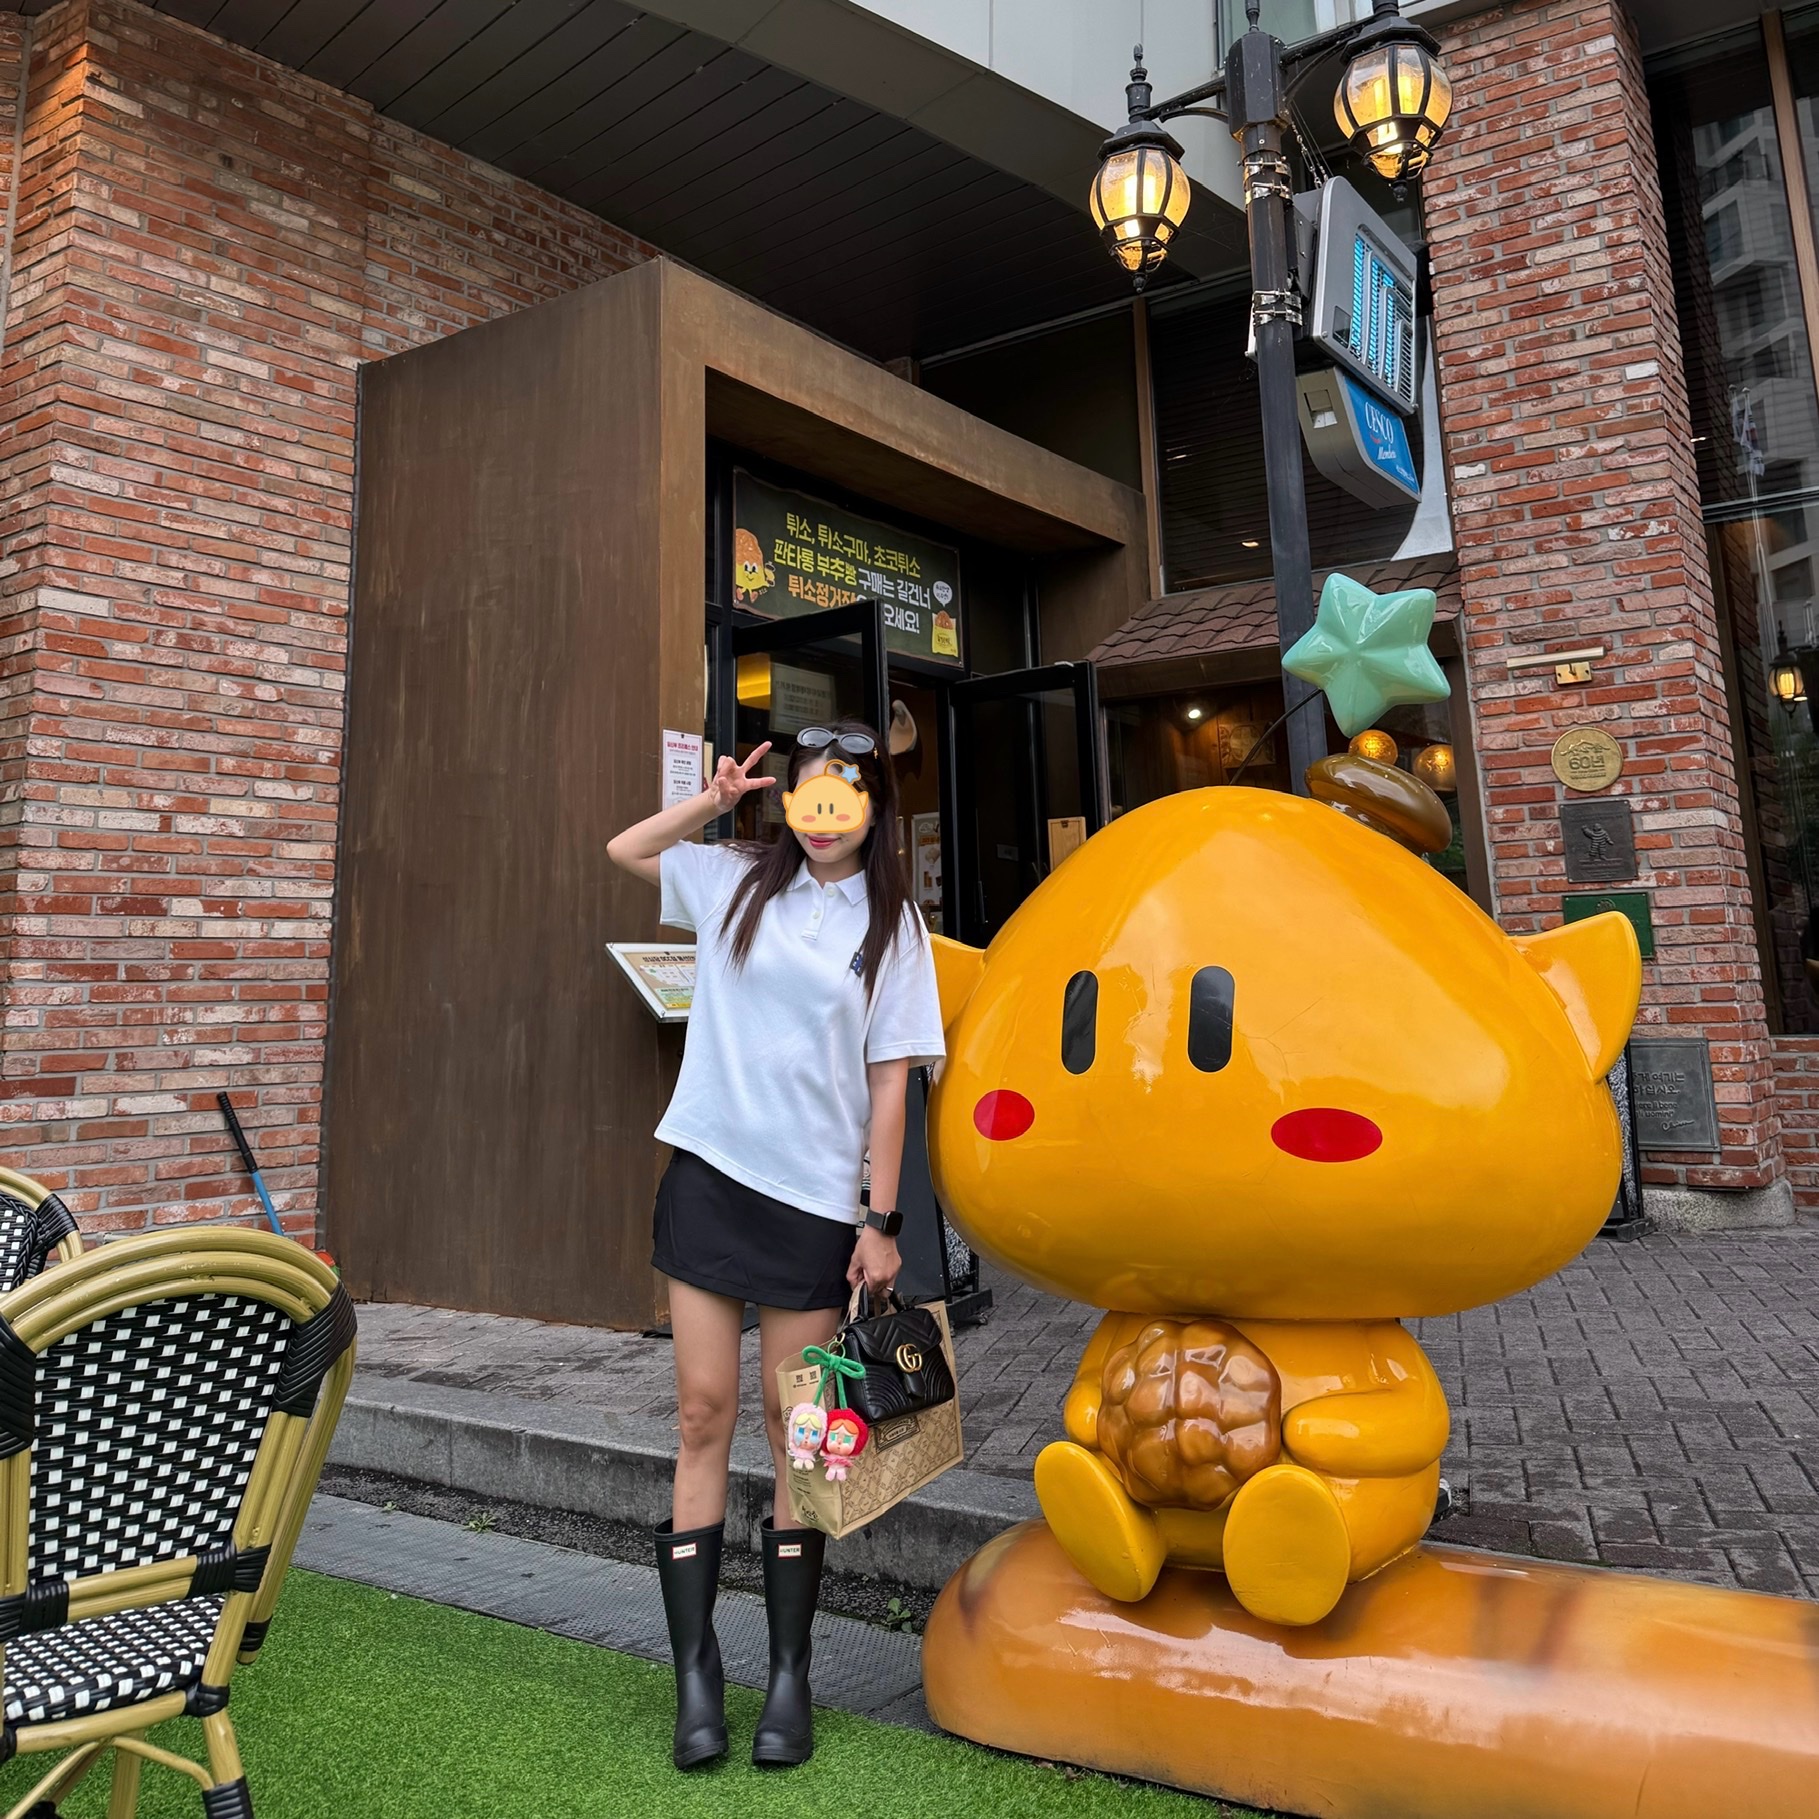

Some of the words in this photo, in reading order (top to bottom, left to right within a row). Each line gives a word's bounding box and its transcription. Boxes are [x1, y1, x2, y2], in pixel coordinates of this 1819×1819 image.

[1365, 401, 1394, 444] CESCO
[786, 512, 815, 545] 튀소,
[818, 523, 871, 565] 튀소구마,
[873, 545, 921, 578] 초코튀소
[774, 538, 814, 573] 판타롱
[817, 552, 857, 586] 부추빵
[858, 567, 895, 598] 구매는
[897, 579, 931, 610] 길건너
[884, 603, 920, 634] 오세요!
[1569, 754, 1605, 770] 60년
